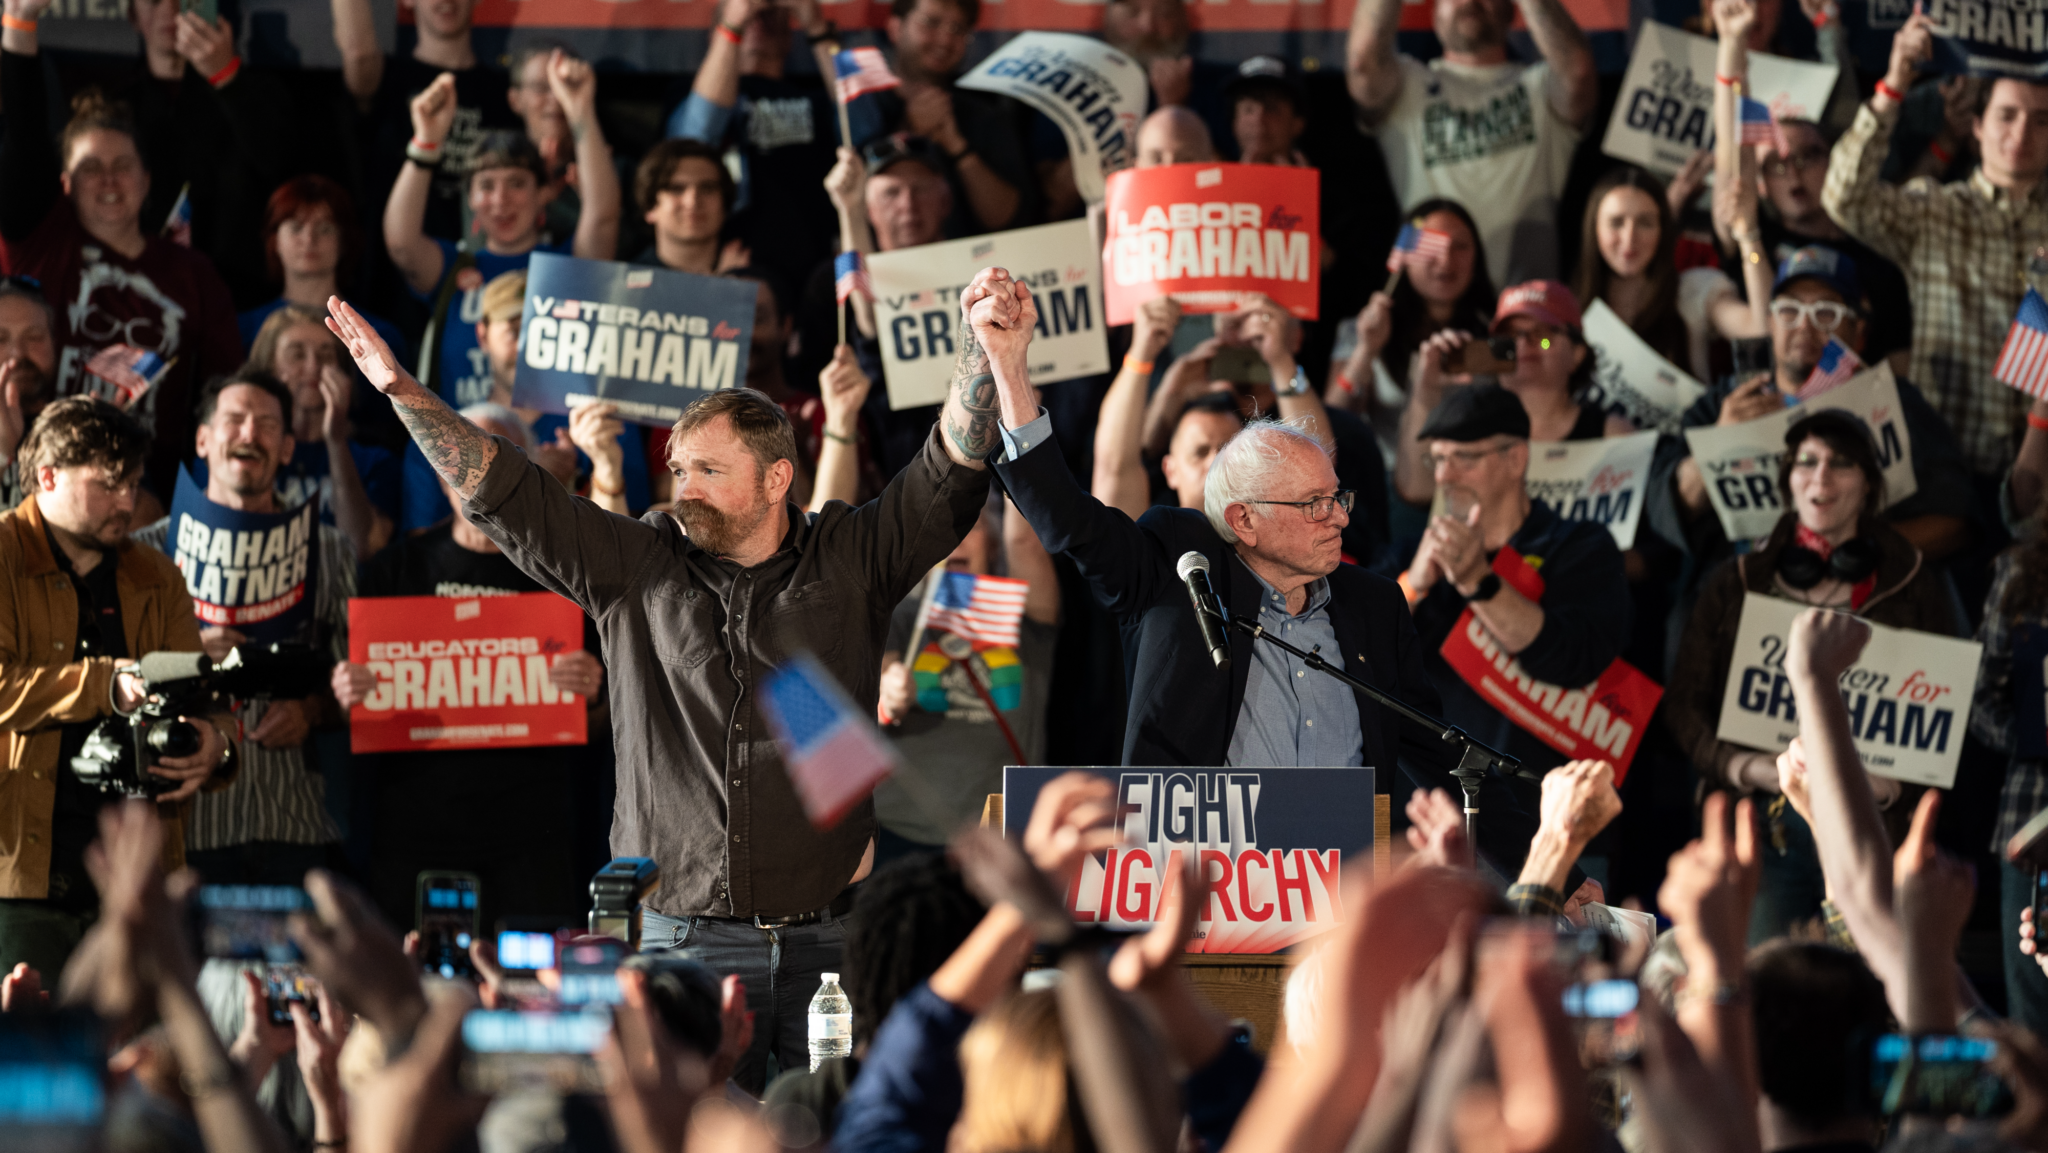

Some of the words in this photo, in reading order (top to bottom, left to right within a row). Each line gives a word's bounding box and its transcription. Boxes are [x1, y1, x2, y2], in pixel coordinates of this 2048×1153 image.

[1927, 0, 2048, 52] GRAH
[1626, 86, 1716, 152] GRA
[1117, 201, 1263, 235] LABOR
[1113, 226, 1312, 287] GRAHAM
[524, 315, 740, 392] GRAHAM
[891, 284, 1093, 362] GRAM
[363, 654, 576, 711] GRAHAM
[367, 637, 539, 661] EDUCATORS
[1759, 634, 1890, 695] Wen
[1896, 669, 1951, 704] for
[1737, 664, 1955, 755] GRHAM
[1113, 772, 1262, 845] FIGHT
[1066, 847, 1342, 924] LIGARCHY
